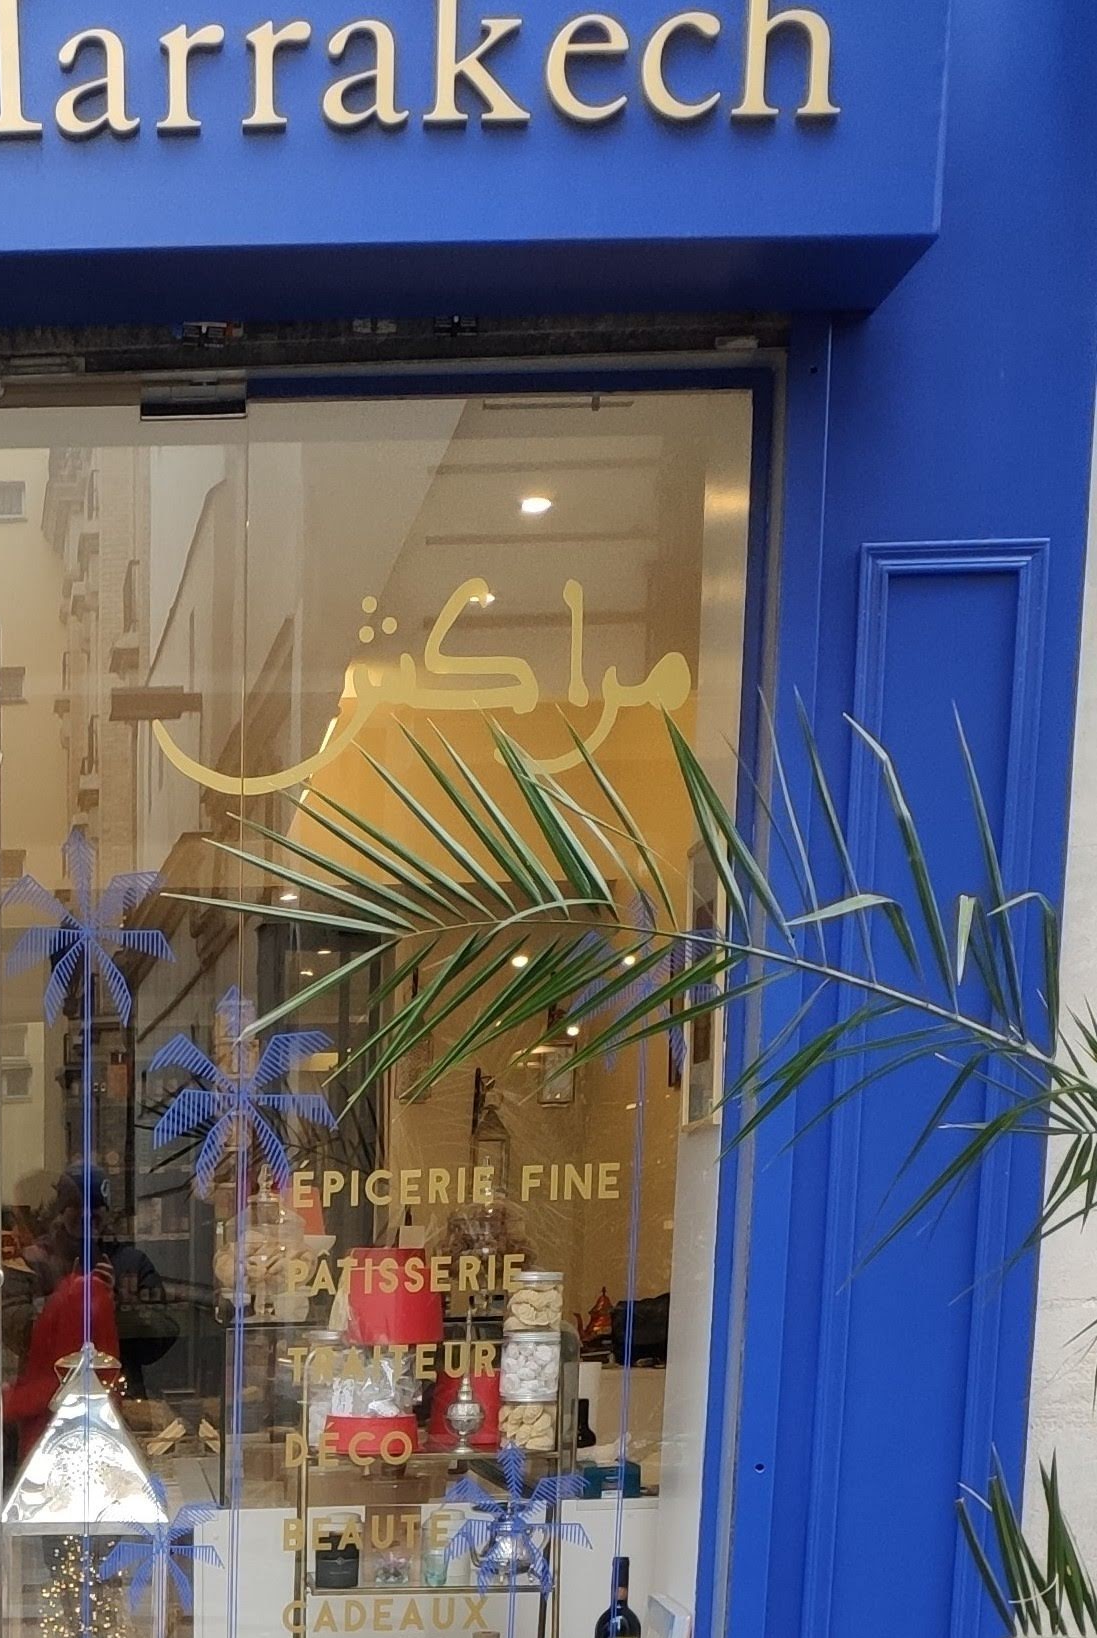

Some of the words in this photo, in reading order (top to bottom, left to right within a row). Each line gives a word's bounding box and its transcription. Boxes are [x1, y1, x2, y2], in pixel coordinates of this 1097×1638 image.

[152, 577, 692, 796] مراكش
[291, 1159, 495, 1209] ÉPICERIE
[521, 1162, 621, 1202] FINE
[287, 1342, 497, 1386] TRAITEUR
[282, 1597, 489, 1634] CADEAUX
